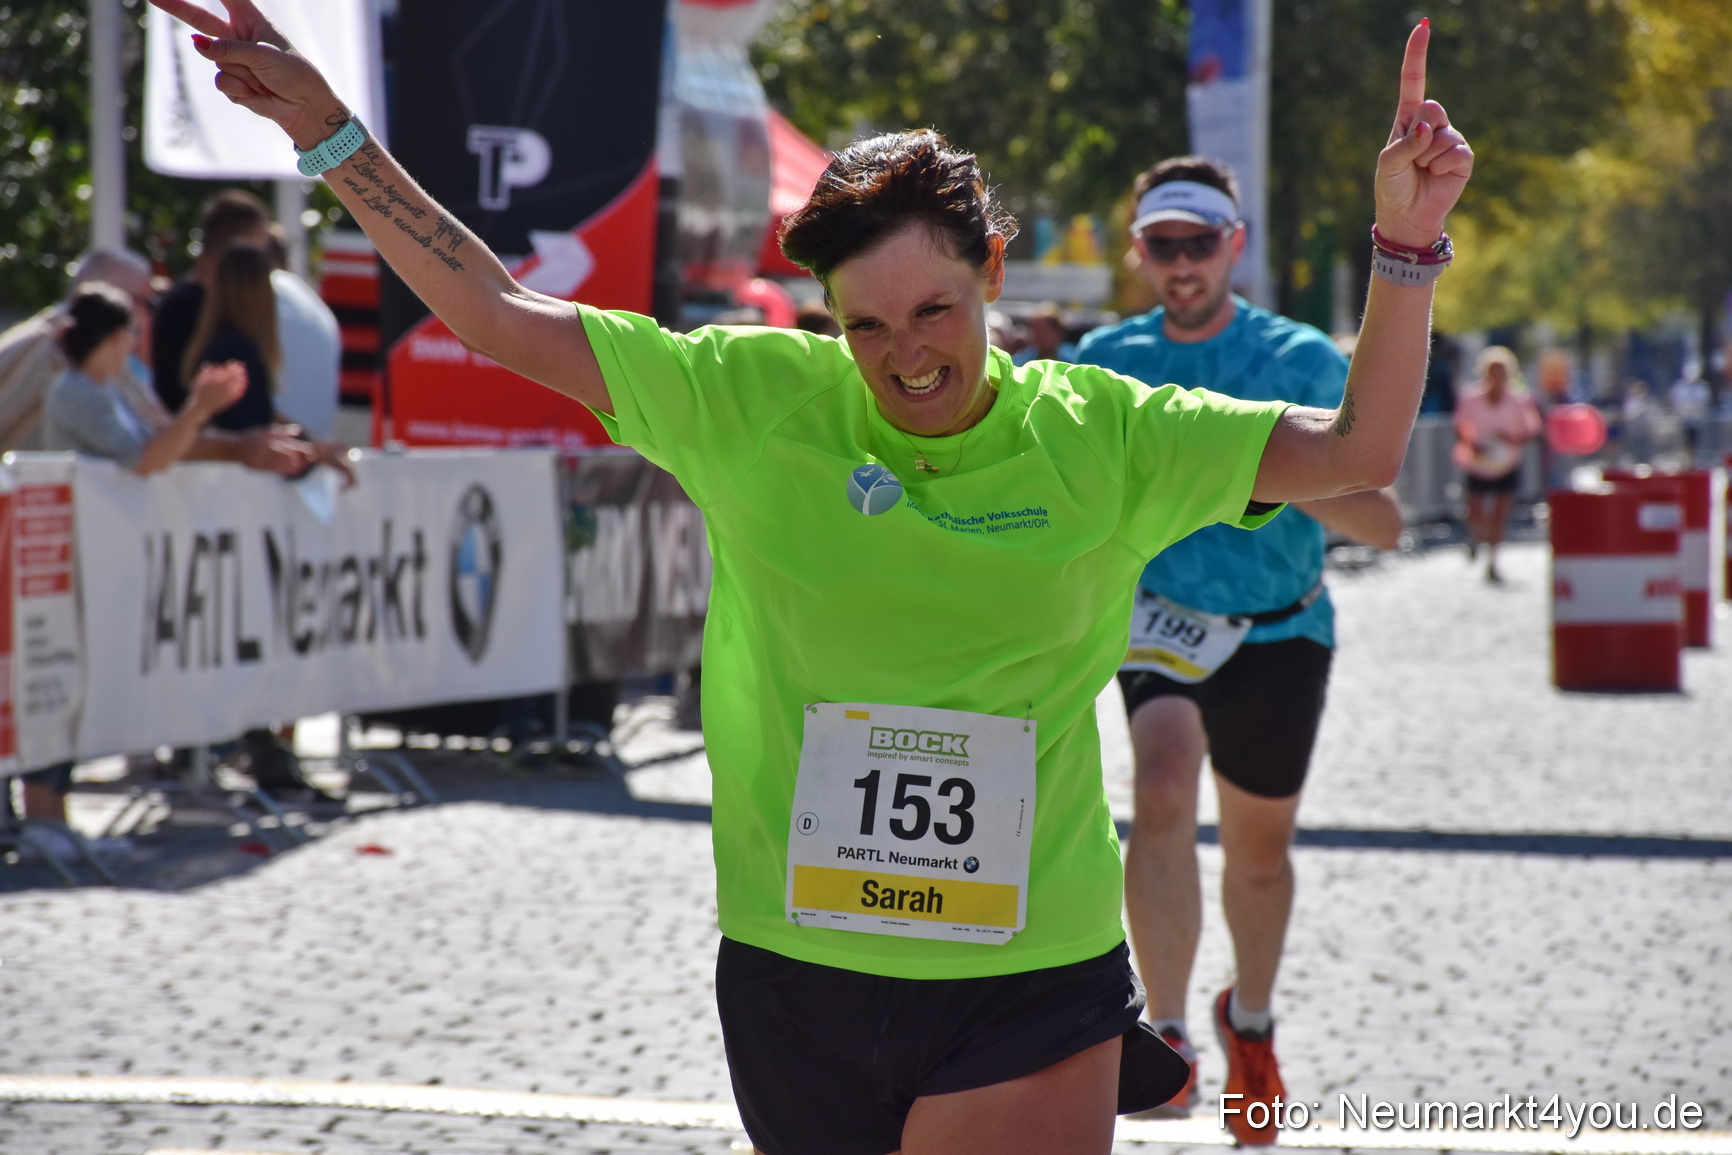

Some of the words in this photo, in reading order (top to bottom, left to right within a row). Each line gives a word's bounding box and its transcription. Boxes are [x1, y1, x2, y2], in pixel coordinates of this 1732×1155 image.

[352, 162, 385, 188] Leben
[383, 185, 428, 220] beginnt
[343, 177, 369, 196] und
[362, 196, 394, 218] Liebe
[393, 217, 432, 248] niemals
[432, 246, 466, 272] endet
[986, 506, 1048, 521] Volksschule
[264, 518, 429, 657] Nearkt
[1144, 609, 1208, 648] 199
[867, 750, 898, 760] inspired
[898, 752, 909, 762] by
[909, 755, 934, 763] smart
[934, 757, 970, 767] concepts
[869, 726, 970, 758] BOCK
[802, 818, 813, 831] D
[853, 769, 977, 846] 153
[837, 846, 885, 863] PARTL
[888, 851, 959, 871] Neumarkt
[860, 879, 944, 915] Sarah
